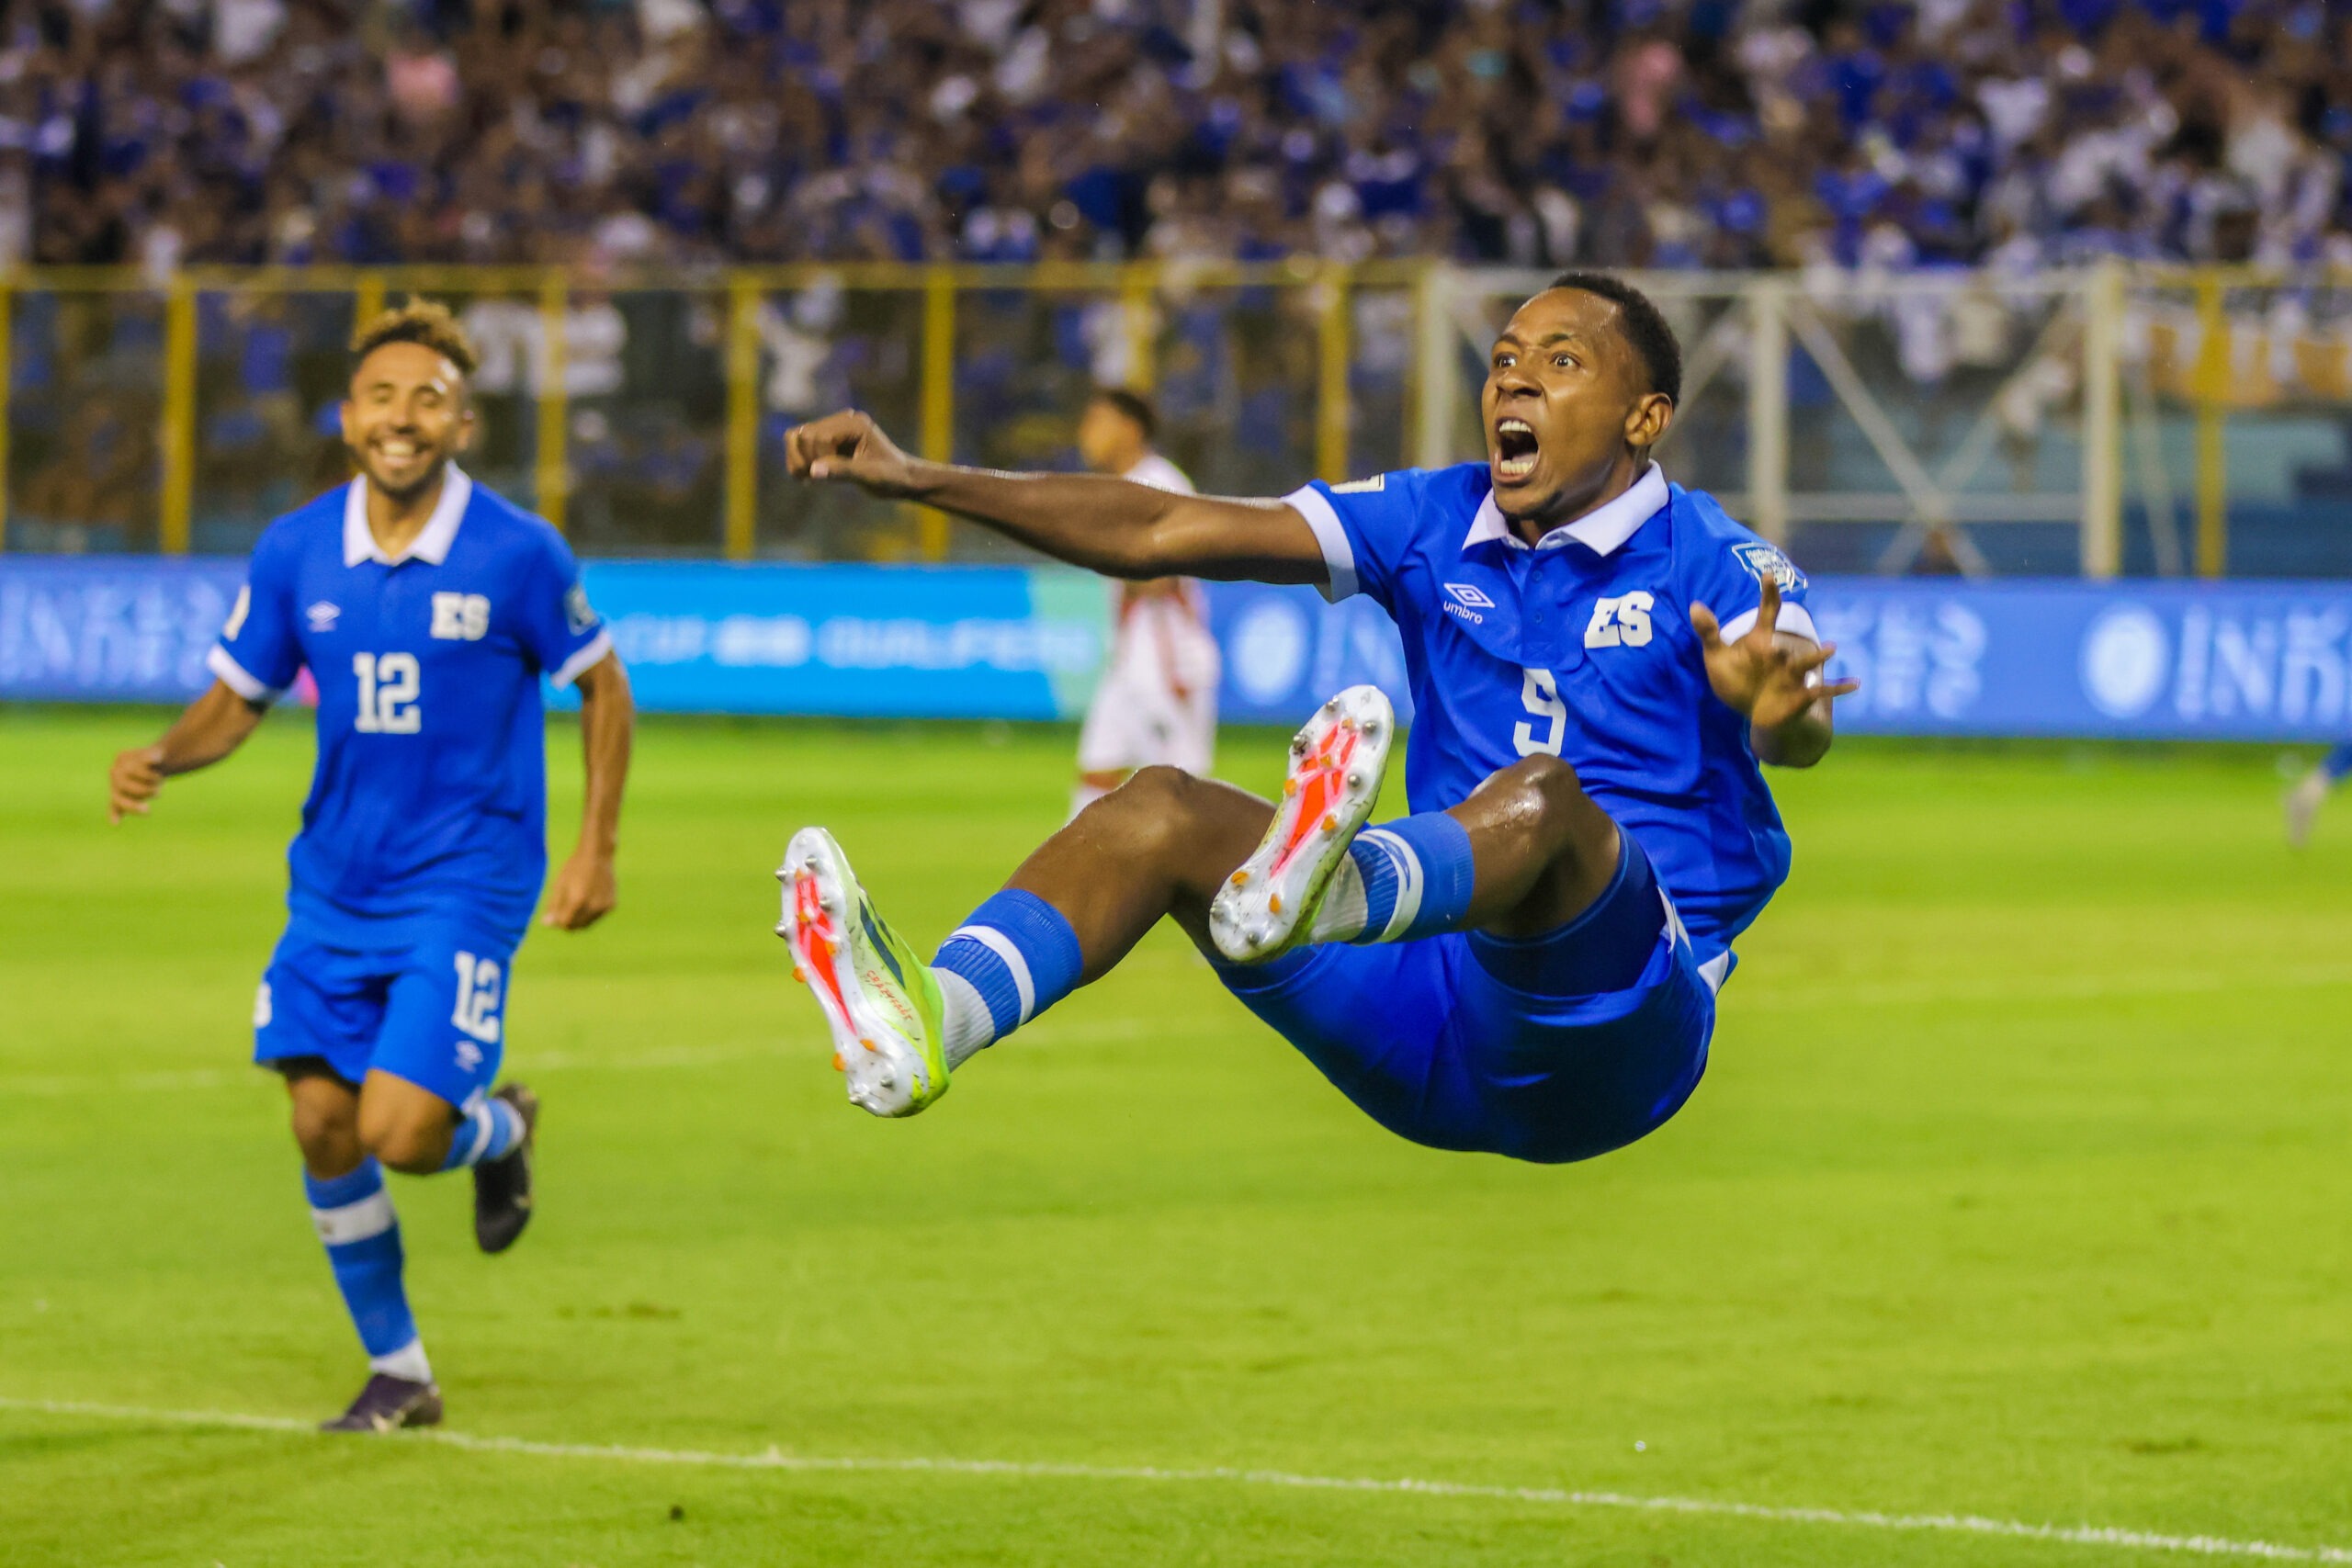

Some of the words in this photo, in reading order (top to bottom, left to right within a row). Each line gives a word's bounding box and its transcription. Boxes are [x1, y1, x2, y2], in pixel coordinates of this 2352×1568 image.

[430, 591, 491, 641] ES
[1443, 600, 1483, 625] umbro
[1584, 590, 1655, 649] ES
[353, 652, 422, 735] 12
[1512, 668, 1566, 758] 9
[450, 950, 501, 1044] 12
